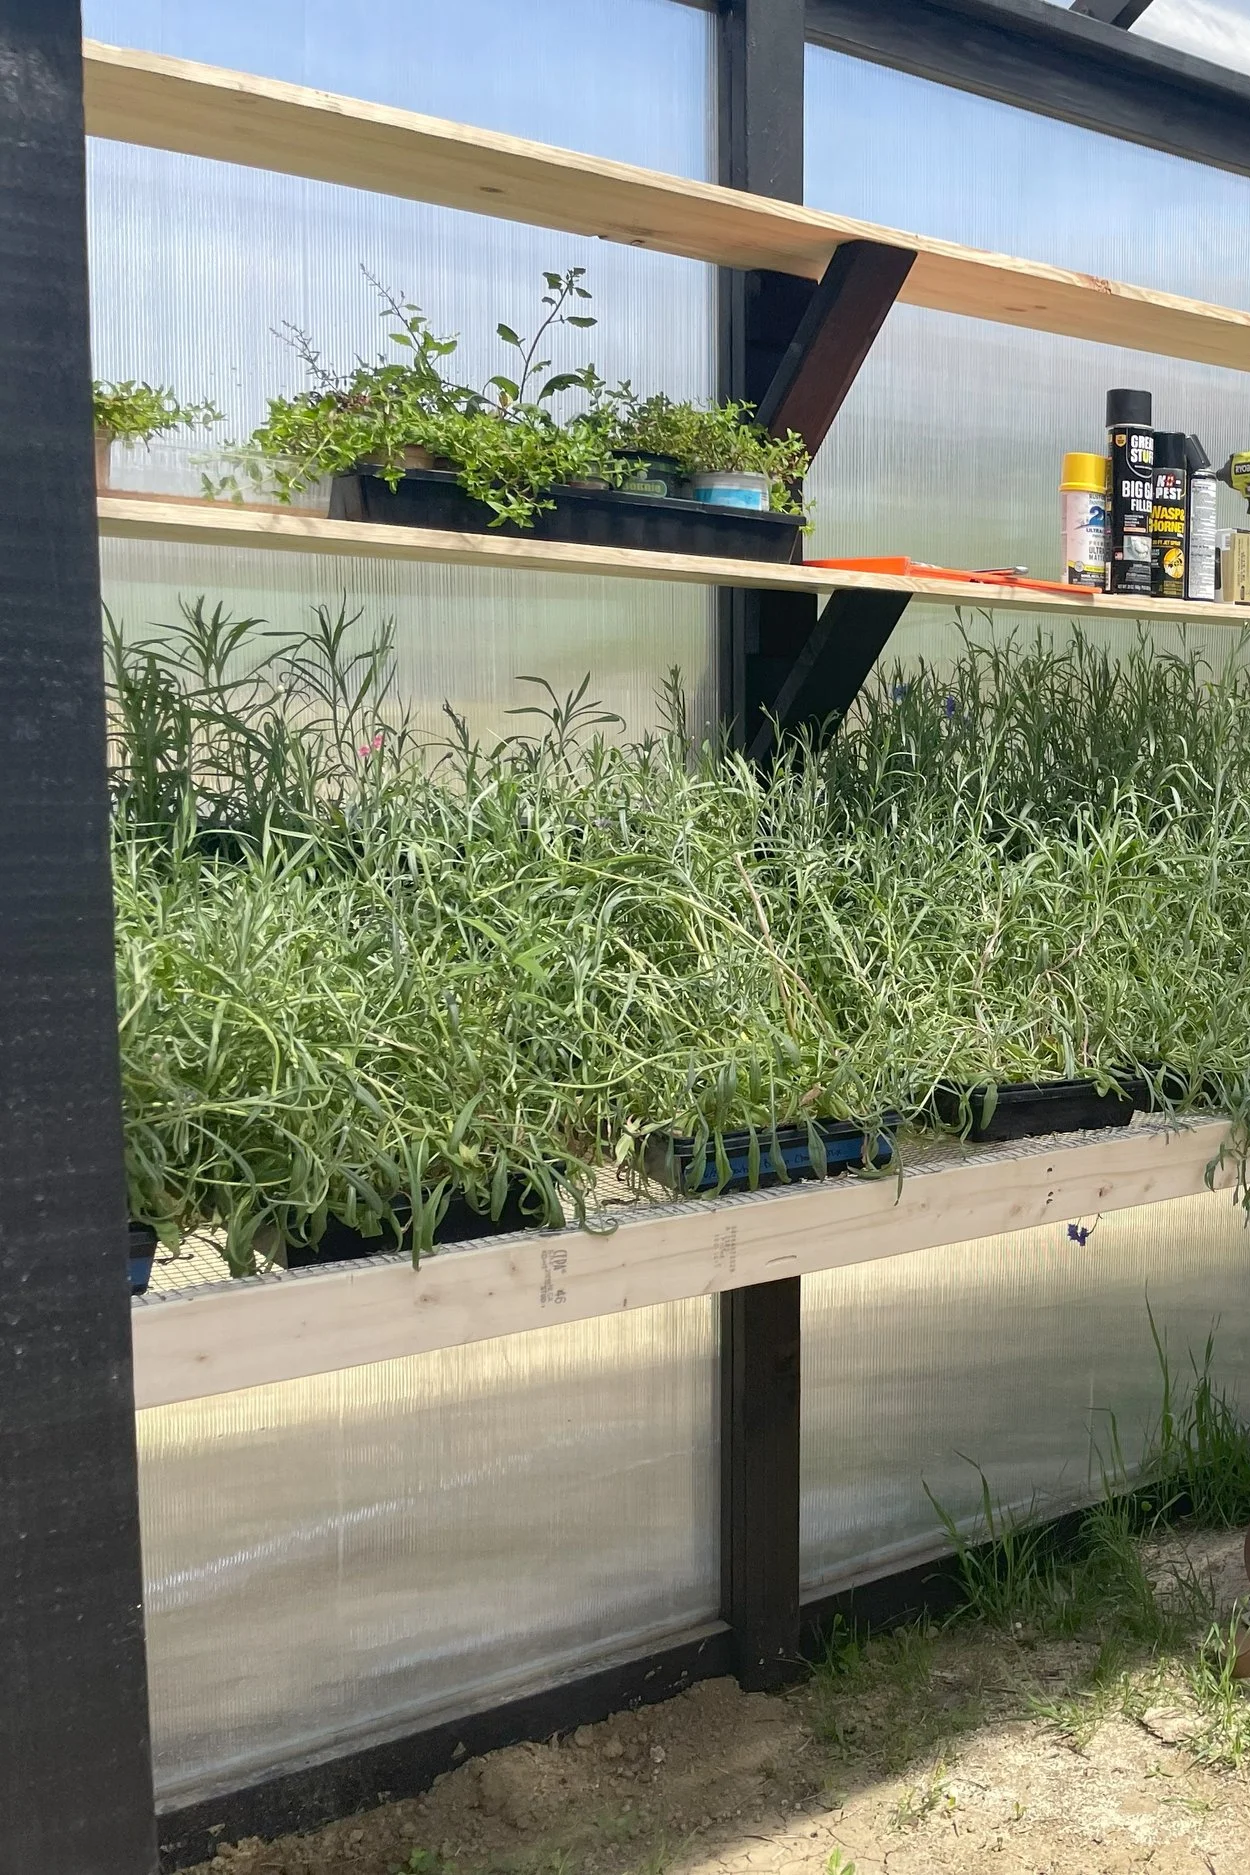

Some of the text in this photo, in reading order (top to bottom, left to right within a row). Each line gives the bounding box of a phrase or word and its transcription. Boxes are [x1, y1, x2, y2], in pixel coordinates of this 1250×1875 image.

[1131, 435, 1154, 451] GREA
[1131, 448, 1154, 466] STUF
[1122, 480, 1143, 498] BIG
[1155, 487, 1182, 500] PEST
[1149, 519, 1185, 534] HORNET
